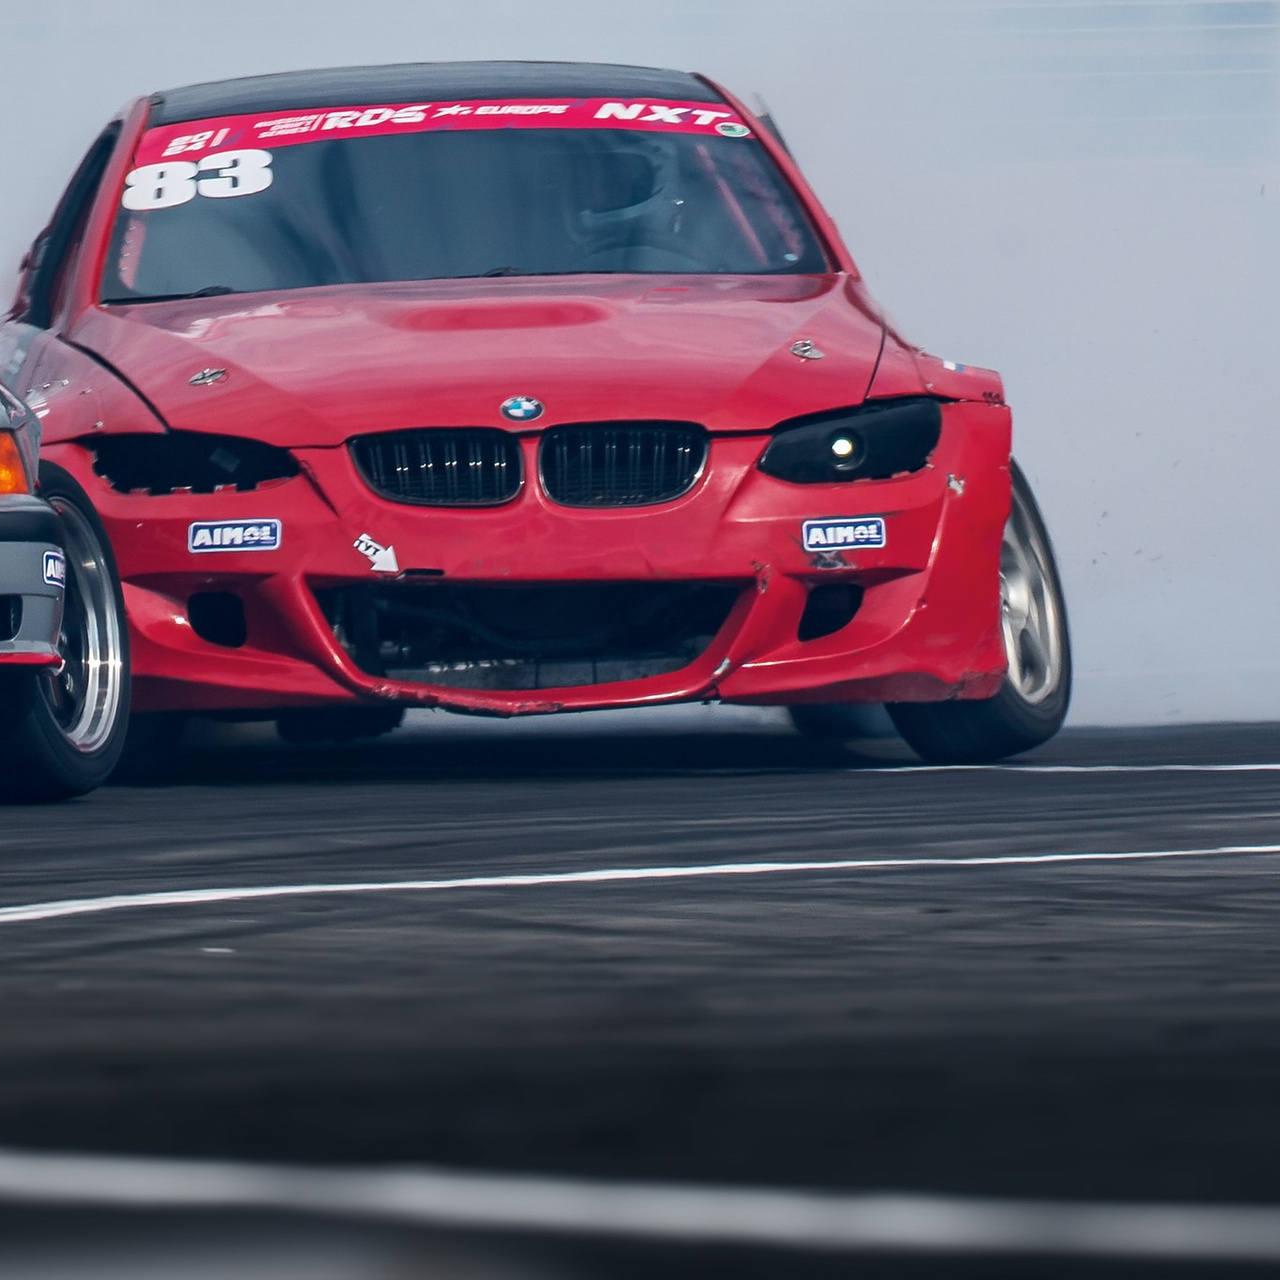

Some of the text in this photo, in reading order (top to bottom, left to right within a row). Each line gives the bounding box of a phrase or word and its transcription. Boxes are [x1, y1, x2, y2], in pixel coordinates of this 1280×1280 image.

[321, 104, 570, 131] RDS EUROPE
[593, 102, 732, 126] NXT
[121, 148, 274, 211] 83
[192, 524, 276, 547] AIMOL
[807, 524, 882, 545] AIMOL
